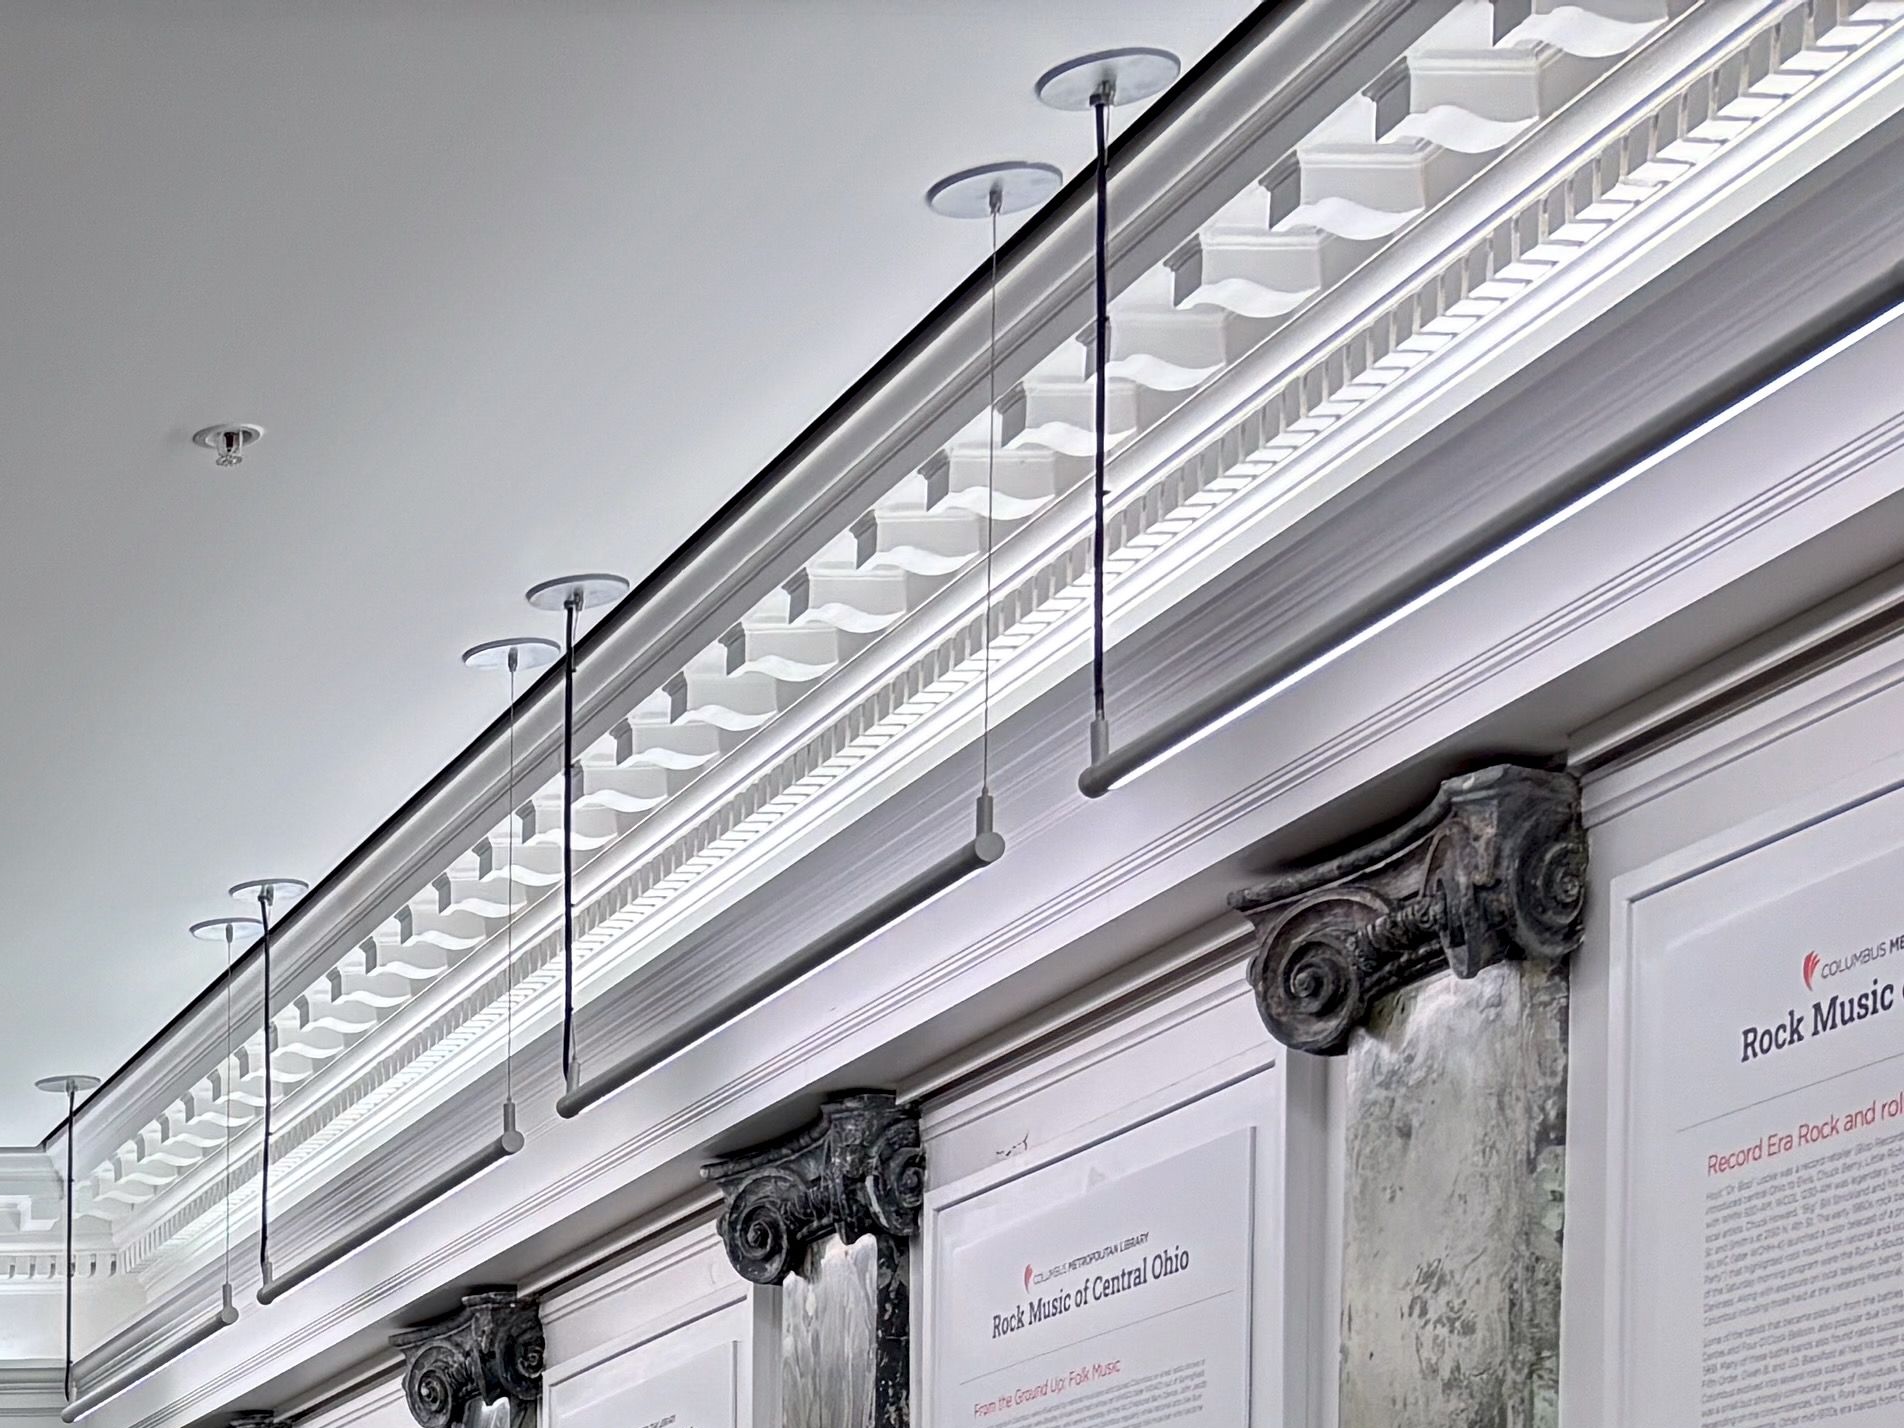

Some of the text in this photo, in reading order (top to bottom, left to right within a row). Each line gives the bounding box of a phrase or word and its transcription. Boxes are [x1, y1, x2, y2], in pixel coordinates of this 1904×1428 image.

[1821, 942, 1886, 979] COLUMBUS
[1741, 978, 1894, 1062] Rock Music
[1707, 1138, 1763, 1176] Record
[1767, 1133, 1793, 1157] Era
[1798, 1114, 1840, 1146] Rock
[1843, 1100, 1876, 1131] and
[1068, 1244, 1118, 1270] METROPOLITAN
[1120, 1232, 1149, 1253] LIBRARY
[992, 1244, 1190, 1339] Rock Music of Central Ohio
[974, 1402, 995, 1418] From
[998, 1394, 1012, 1410] the
[1014, 1381, 1049, 1405] Ground
[1068, 1366, 1090, 1387] Folk
[1092, 1360, 1121, 1380] Music
